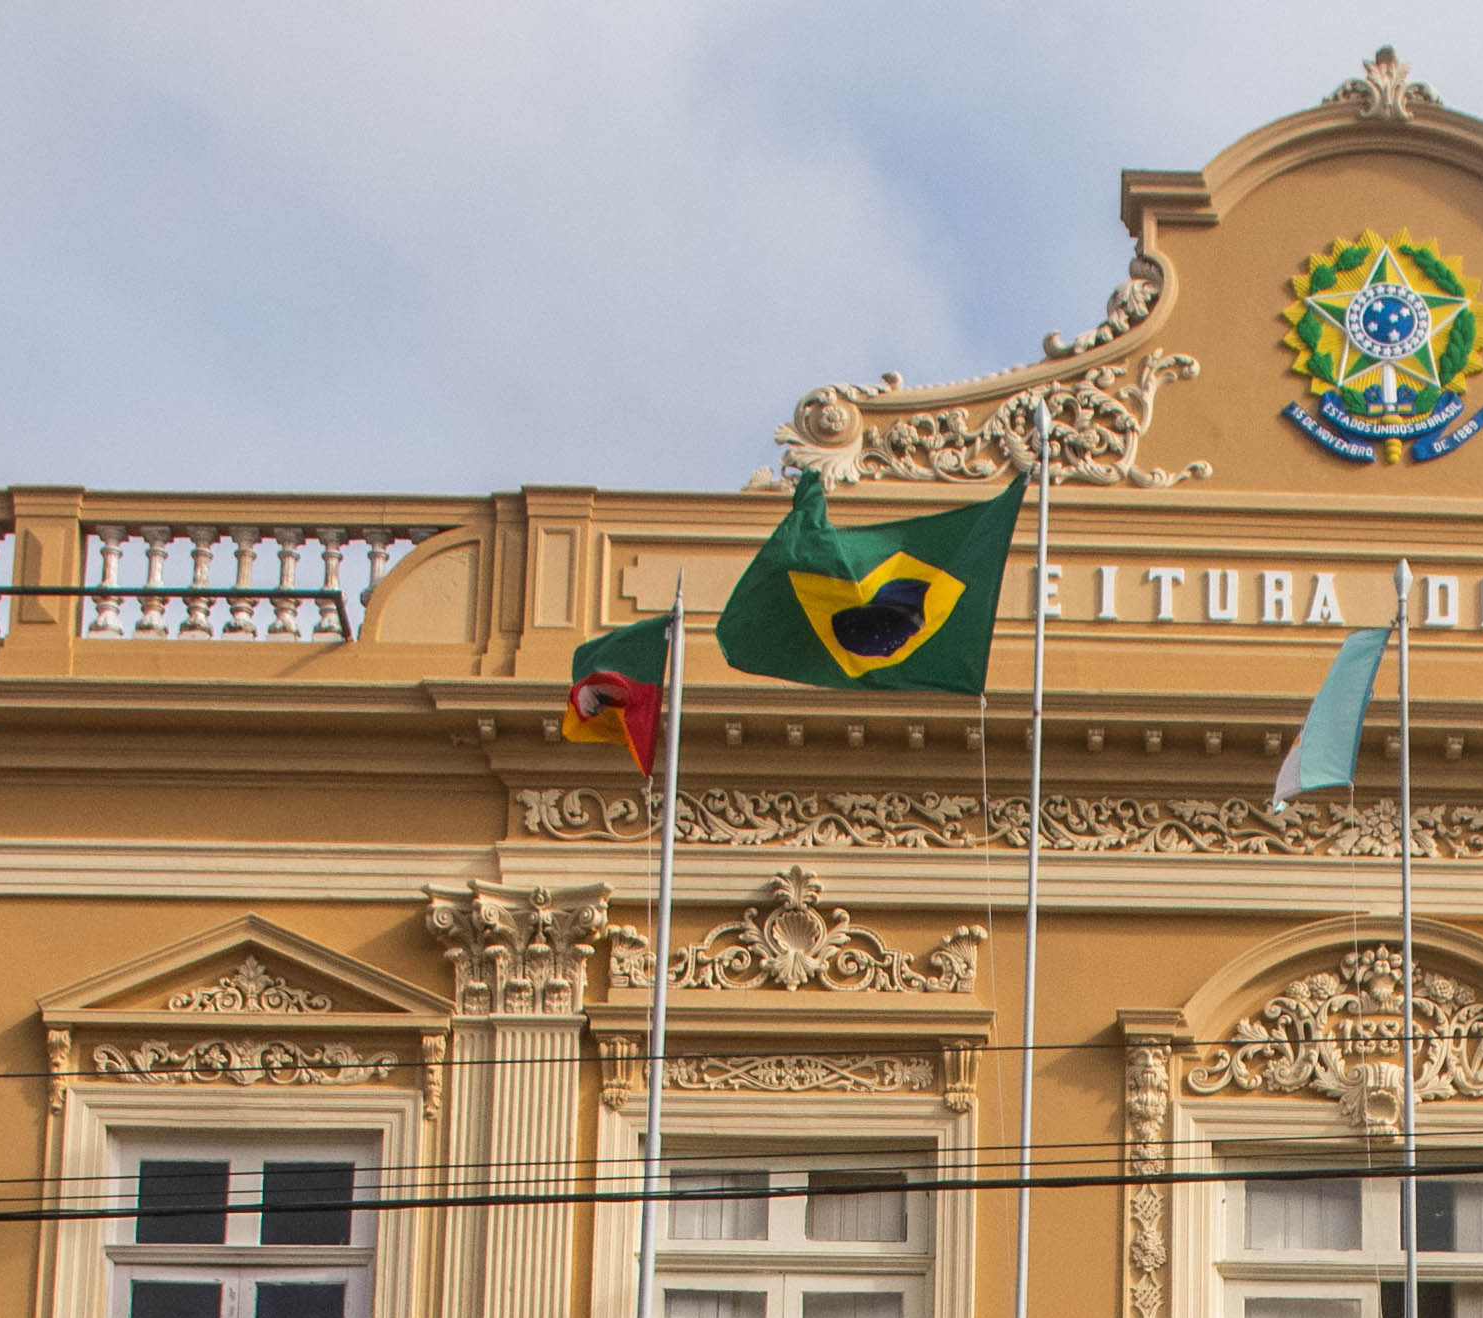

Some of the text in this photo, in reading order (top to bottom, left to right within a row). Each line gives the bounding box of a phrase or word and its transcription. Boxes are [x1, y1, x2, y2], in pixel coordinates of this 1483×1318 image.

[1292, 407, 1374, 458] 15 DE NOVEMBRO
[1323, 402, 1463, 434] ESTADOS UNIDOS DO BRASIL
[1433, 420, 1479, 453] DE 1889
[1034, 565, 1345, 626] EITURA
